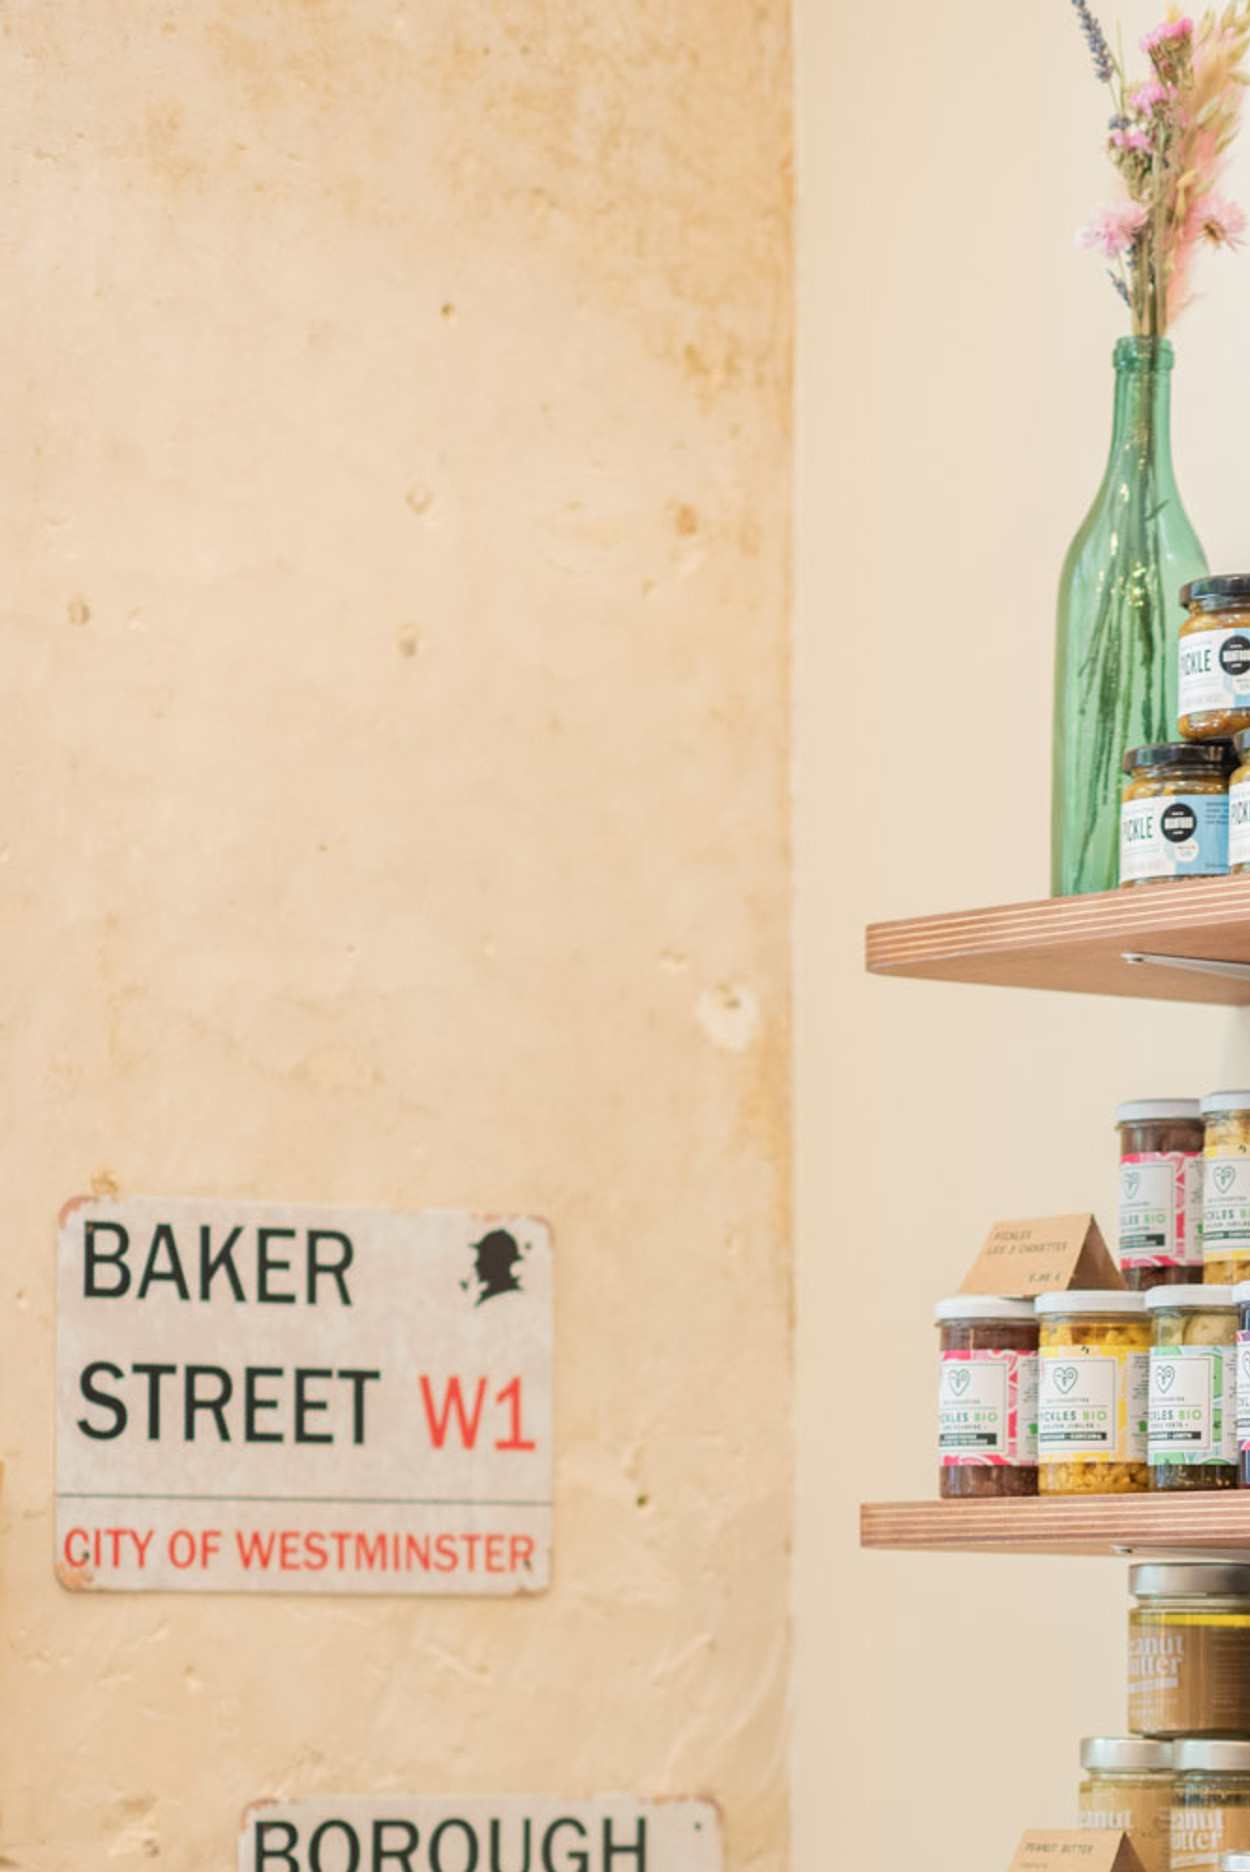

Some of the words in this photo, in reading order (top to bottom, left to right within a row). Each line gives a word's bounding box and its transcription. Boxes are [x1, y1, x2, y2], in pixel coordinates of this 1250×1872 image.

[82, 1221, 354, 1307] BAKER
[77, 1361, 381, 1445] STREET
[419, 1375, 537, 1452] W1
[973, 1410, 998, 1424] BIO
[1083, 1410, 1108, 1422] BIO
[1178, 1410, 1202, 1421] BIO
[63, 1528, 157, 1571] CITY
[168, 1529, 221, 1571] OF
[235, 1531, 536, 1575] WESTMINSTER
[1025, 1841, 1059, 1854] PEANUT
[1060, 1843, 1095, 1855] BUTTER
